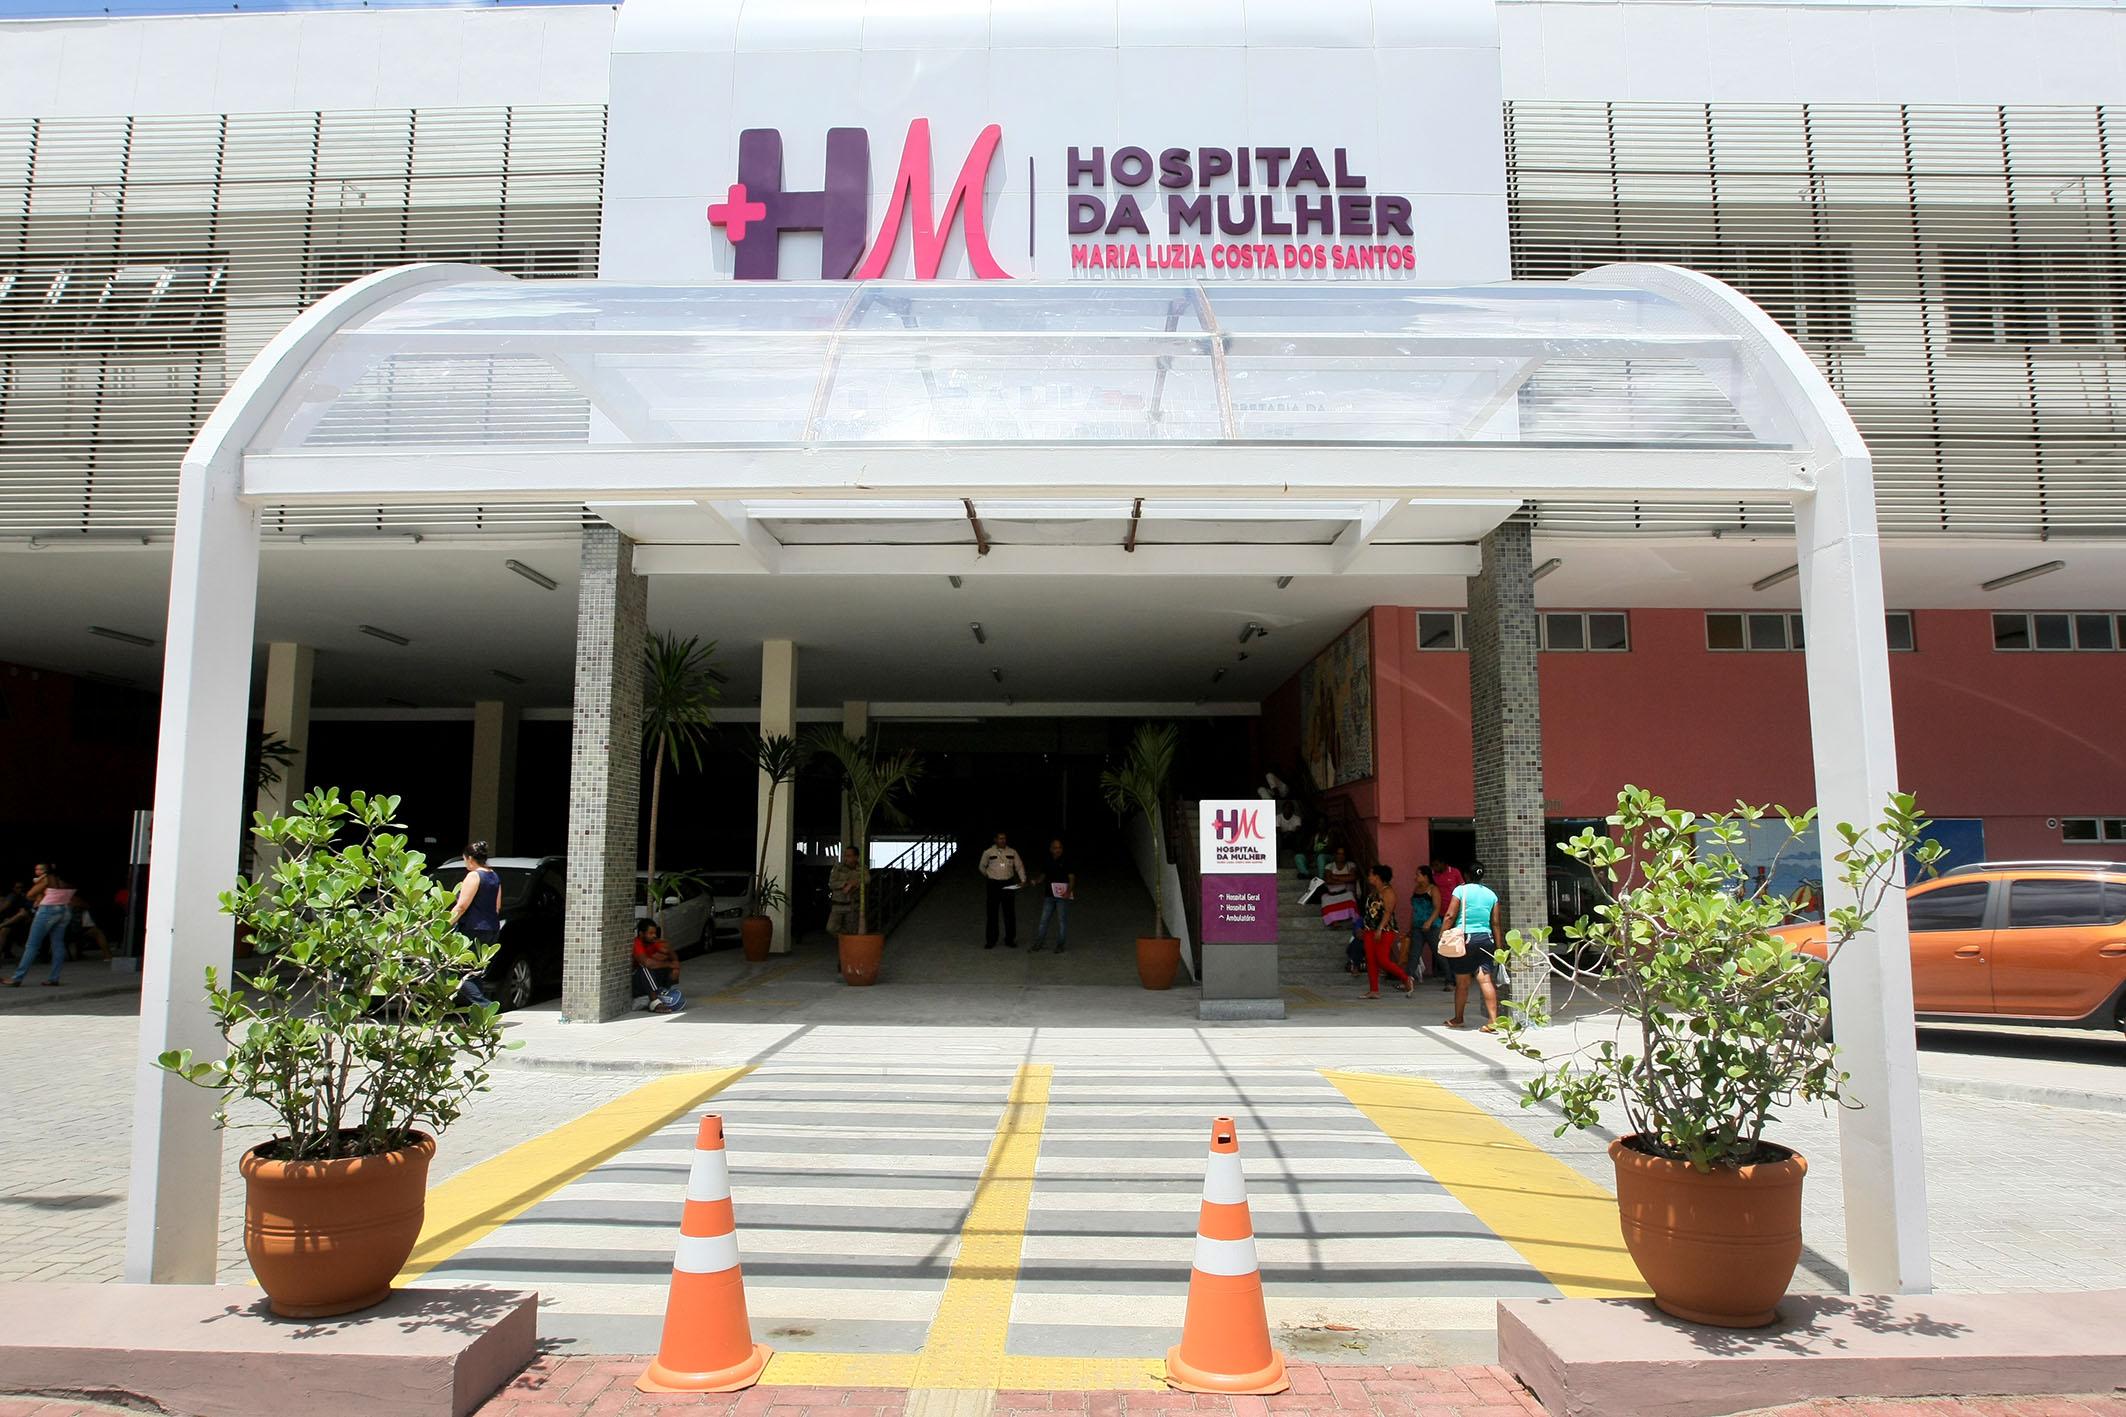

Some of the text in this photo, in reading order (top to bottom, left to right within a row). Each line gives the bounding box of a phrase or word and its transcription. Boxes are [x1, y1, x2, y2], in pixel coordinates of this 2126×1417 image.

[1067, 146, 1367, 188] HOSPITAL
[734, 118, 1016, 279] HM
[1068, 194, 1414, 236] DA MULHER
[1071, 244, 1415, 269] MARIA LUZIA COSTA DOS SANTOS
[1216, 807, 1266, 844] HM
[1226, 893, 1260, 901] Hospital Geral
[1226, 903, 1256, 911] Hospital Dia
[1226, 914, 1256, 922] Ambulatório
